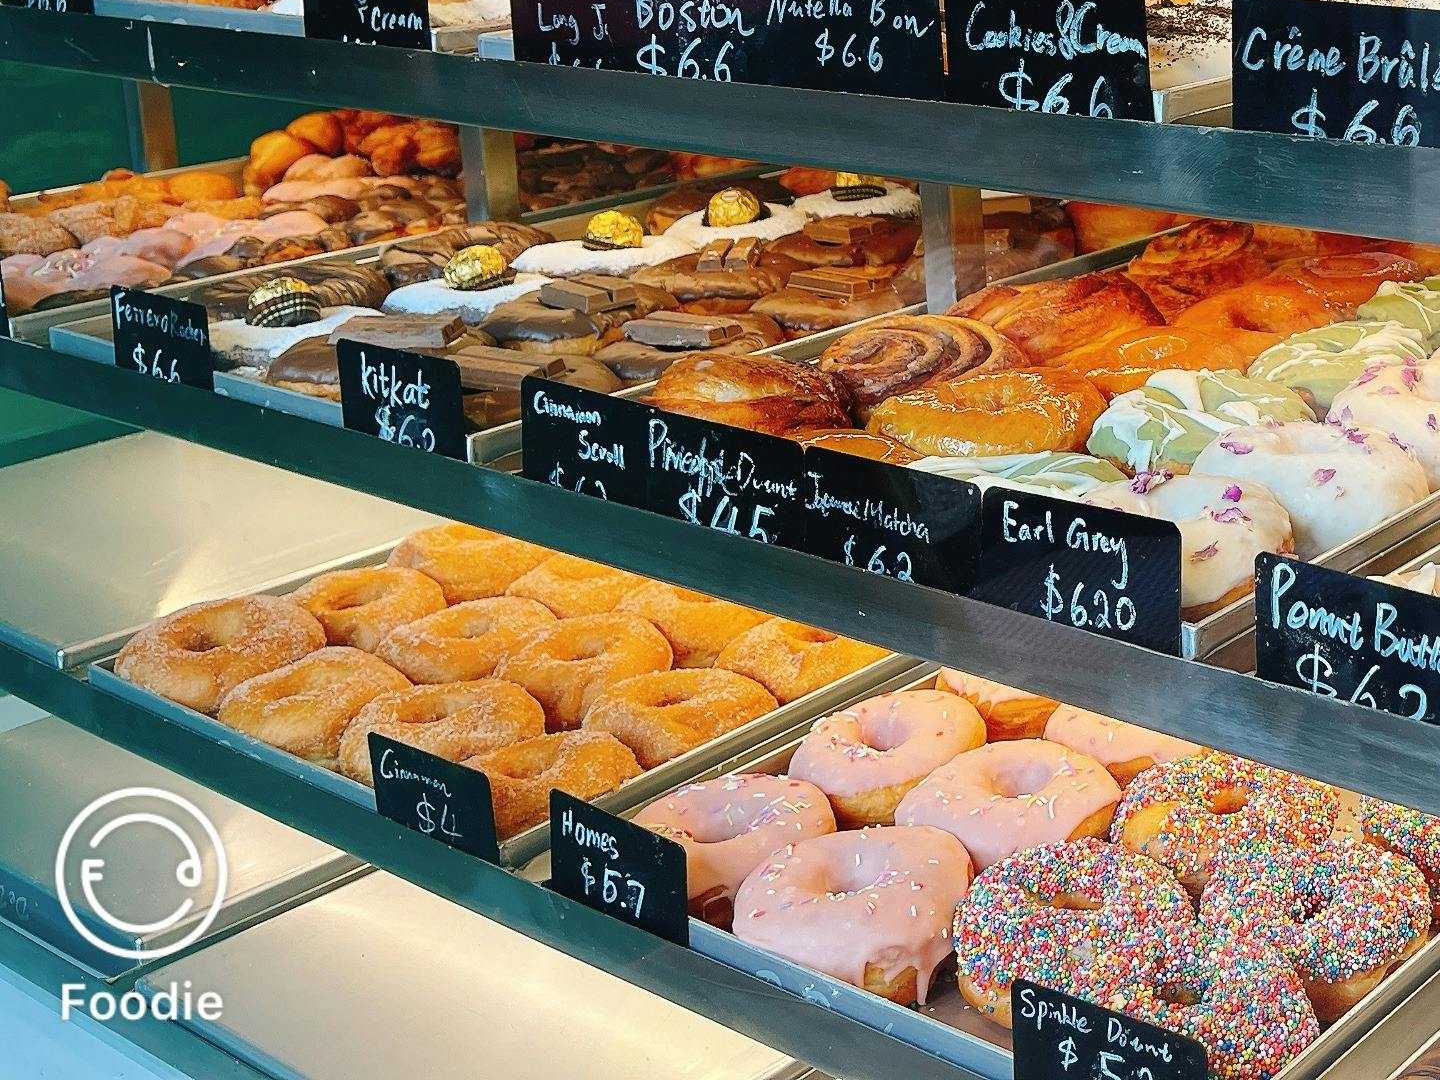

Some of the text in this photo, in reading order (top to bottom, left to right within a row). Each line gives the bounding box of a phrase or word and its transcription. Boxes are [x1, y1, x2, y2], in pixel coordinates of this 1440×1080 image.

[537, 2, 580, 46] Long
[814, 27, 884, 73] $6.6
[1002, 501, 1128, 590] Earl Grey
[1040, 564, 1137, 631] $6.20
[416, 793, 463, 835] $4
[580, 857, 647, 920] $5.7
